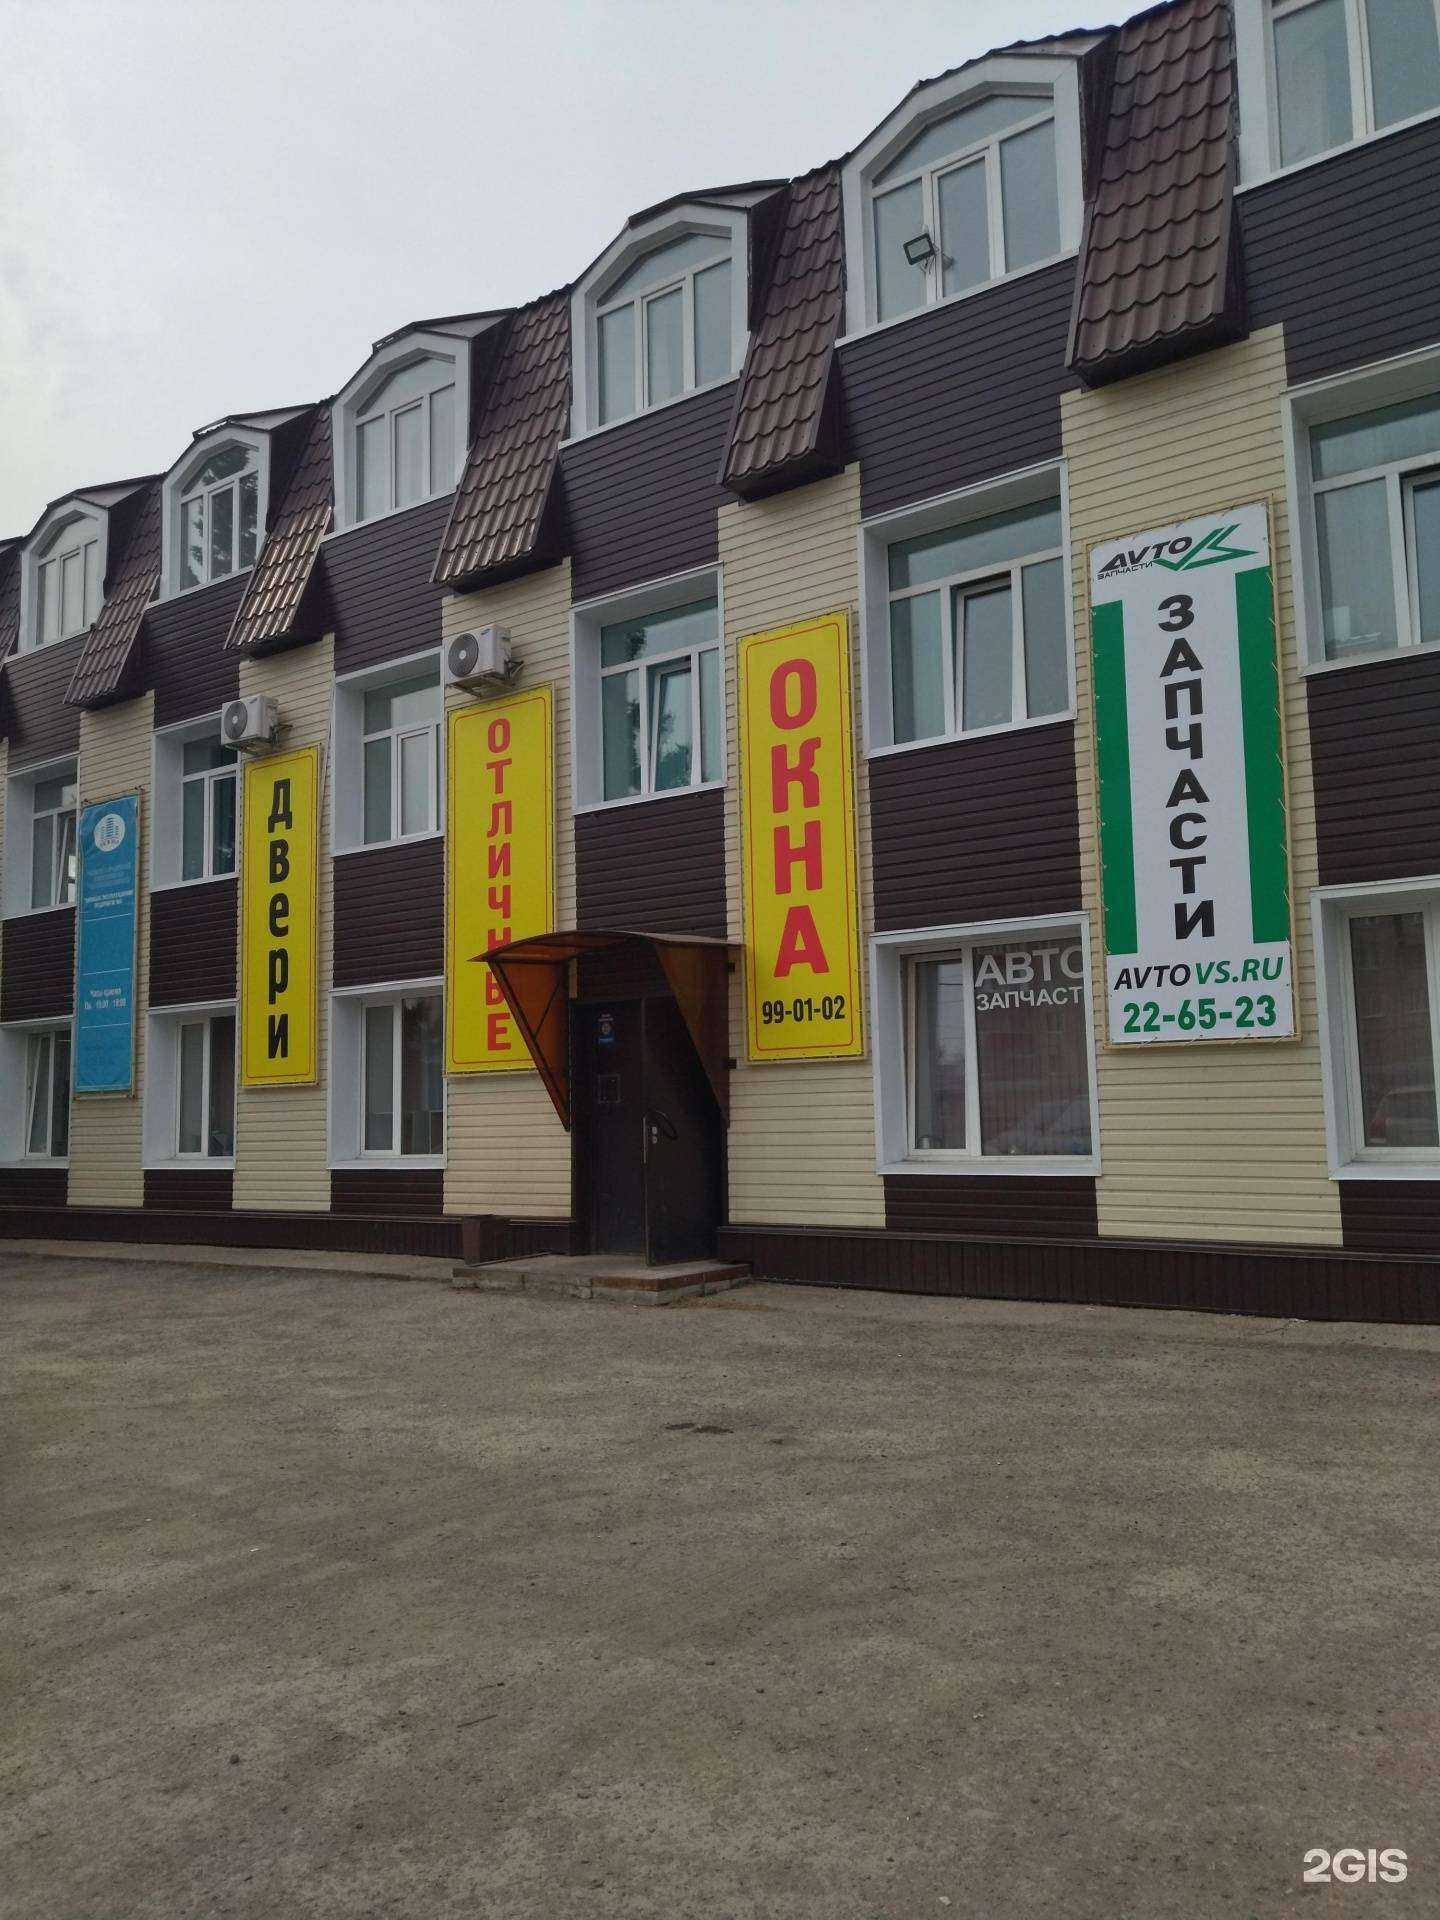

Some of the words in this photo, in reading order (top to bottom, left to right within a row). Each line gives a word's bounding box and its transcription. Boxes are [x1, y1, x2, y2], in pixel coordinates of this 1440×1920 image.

[1097, 561, 1154, 581] ЗАПЧАСТИ
[1098, 536, 1193, 574] AVTO
[1158, 594, 1215, 940] ЗАПЧАСТИ
[769, 658, 829, 978] ОКНА
[762, 995, 845, 1025] 99-01-02
[1123, 995, 1276, 1033] 22-65-23
